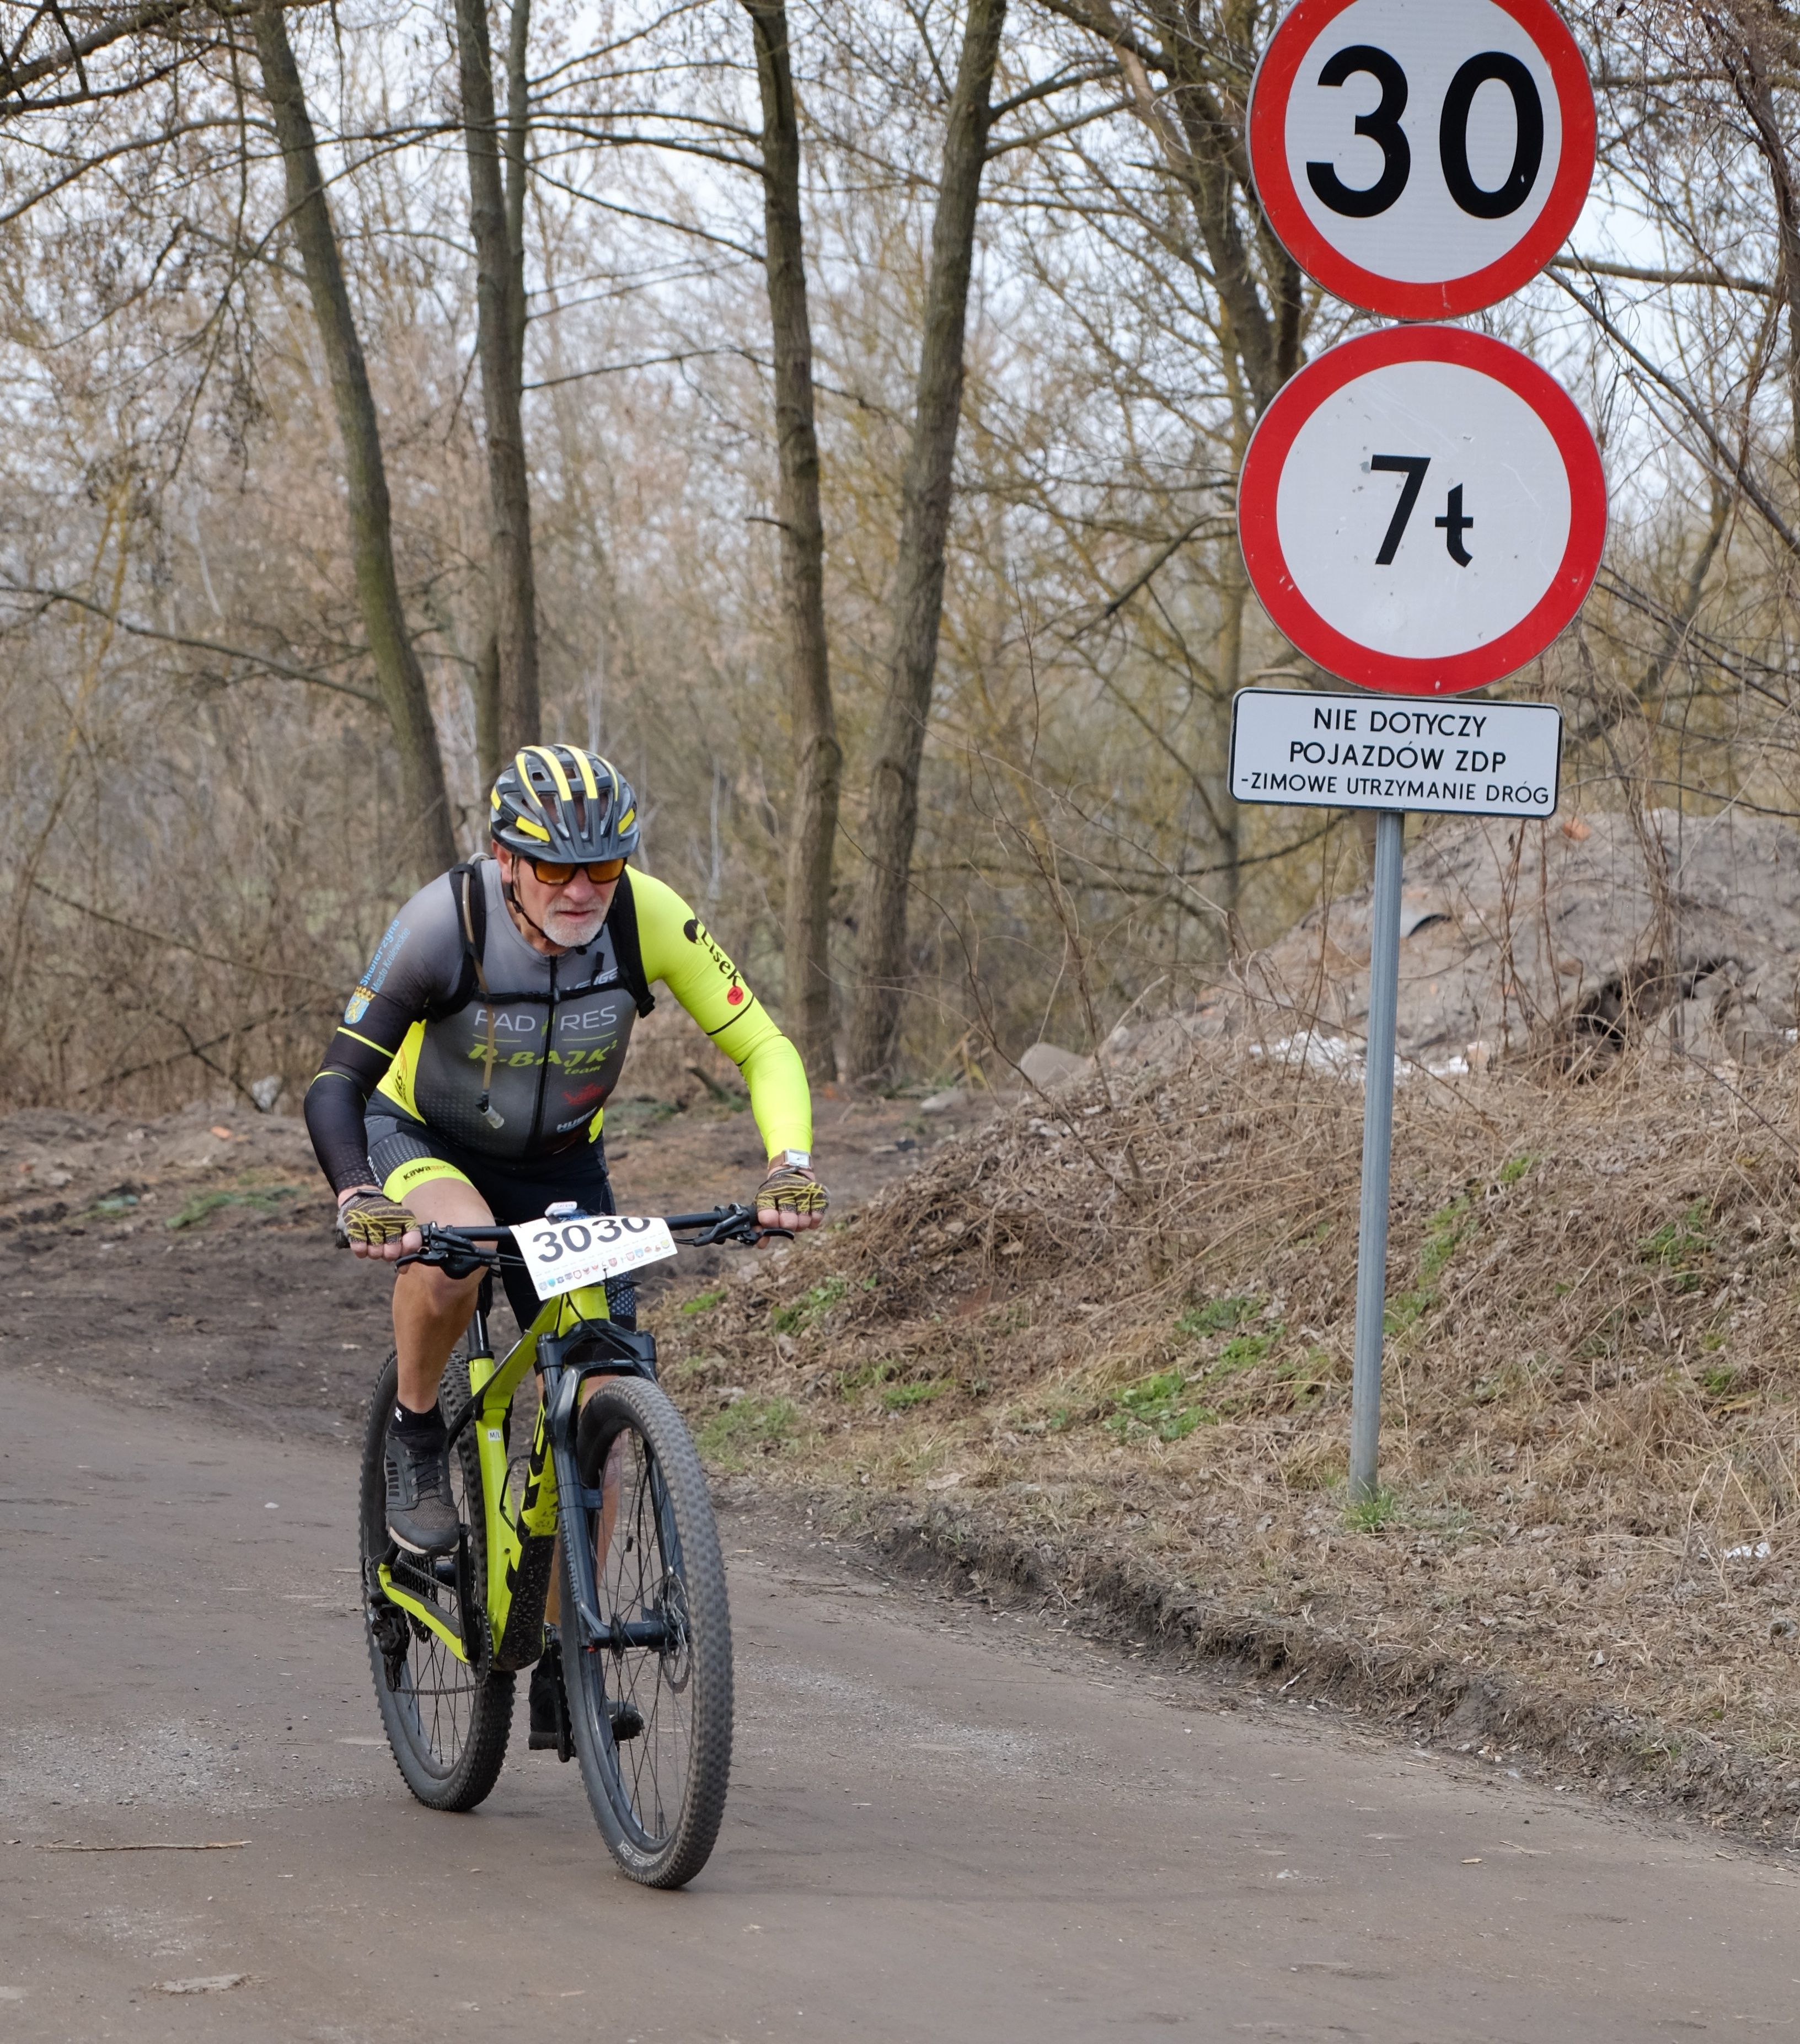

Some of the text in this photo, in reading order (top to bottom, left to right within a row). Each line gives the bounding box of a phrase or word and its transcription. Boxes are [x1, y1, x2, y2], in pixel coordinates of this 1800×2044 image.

[1306, 44, 1544, 220] 30
[1370, 454, 1474, 568] 7t
[1313, 707, 1487, 737] NIE DOTYCZY
[1289, 741, 1507, 773] POJAZDÓW ZDP
[1241, 772, 1549, 805] -ZIMOWE UTRZYMANIE DRÓG
[532, 1217, 651, 1262] 3030
